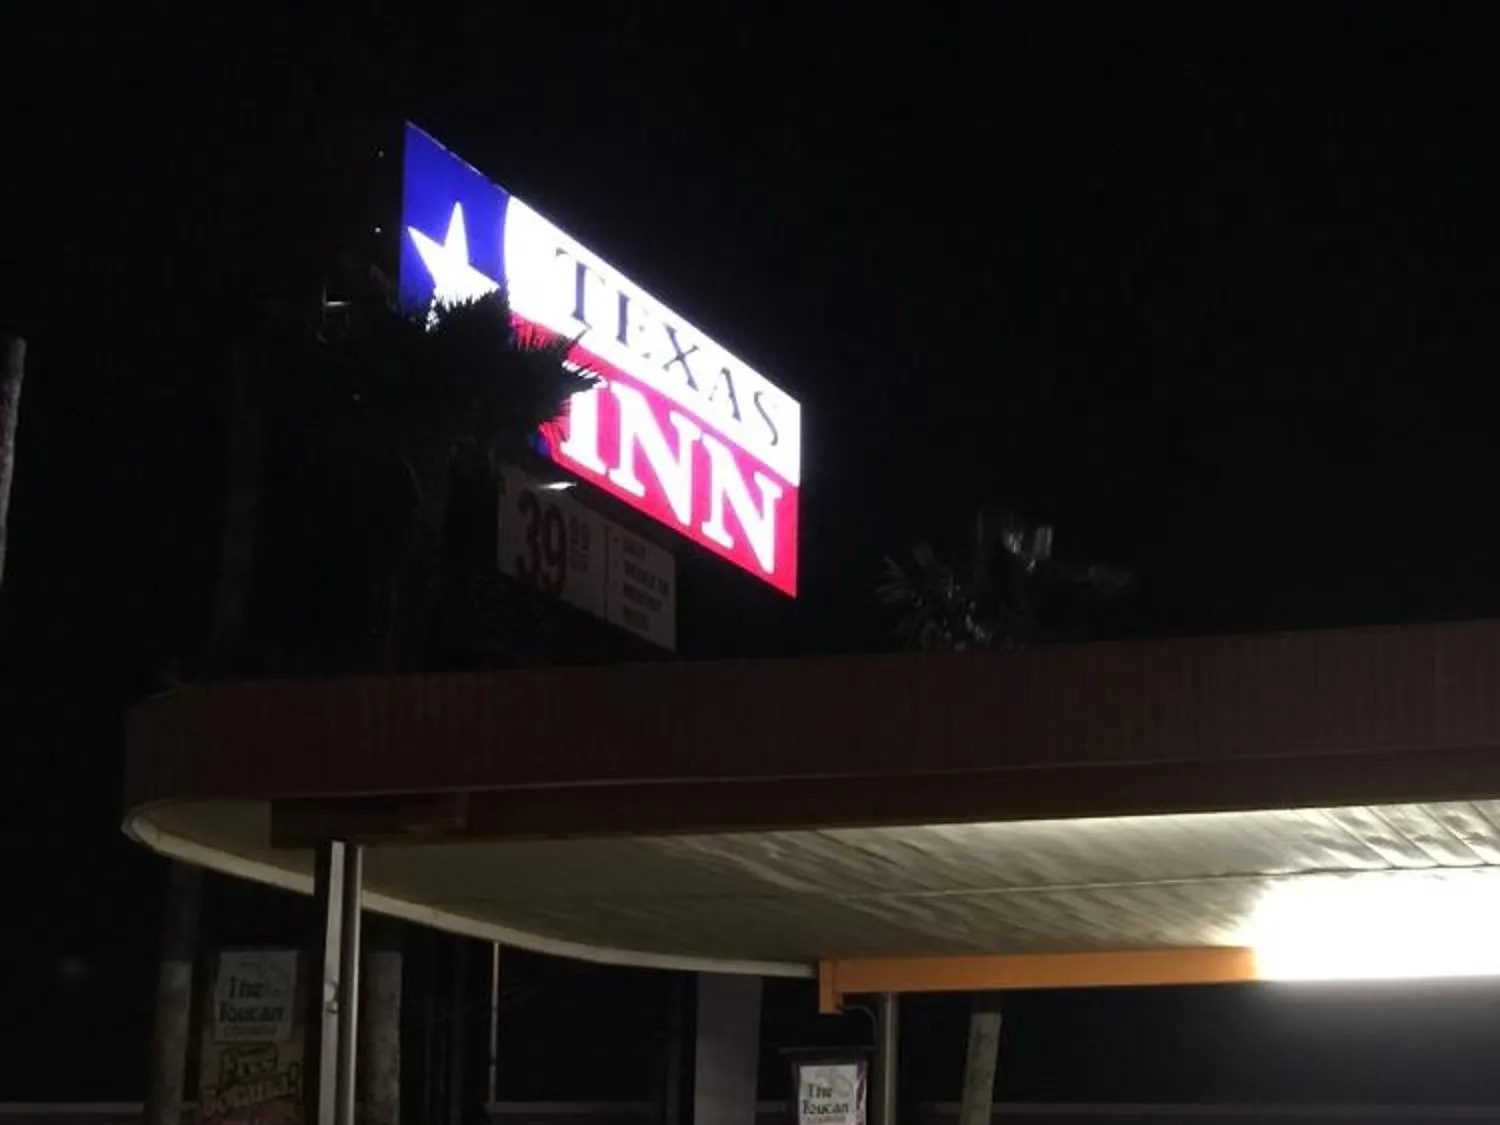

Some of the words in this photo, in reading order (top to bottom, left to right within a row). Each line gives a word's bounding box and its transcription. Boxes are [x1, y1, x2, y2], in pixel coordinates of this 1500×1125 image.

[555, 246, 780, 447] TEXAS
[560, 379, 783, 575] INN
[515, 489, 567, 598] 39
[802, 1099, 849, 1115] Toucan
[808, 1083, 834, 1098] The
